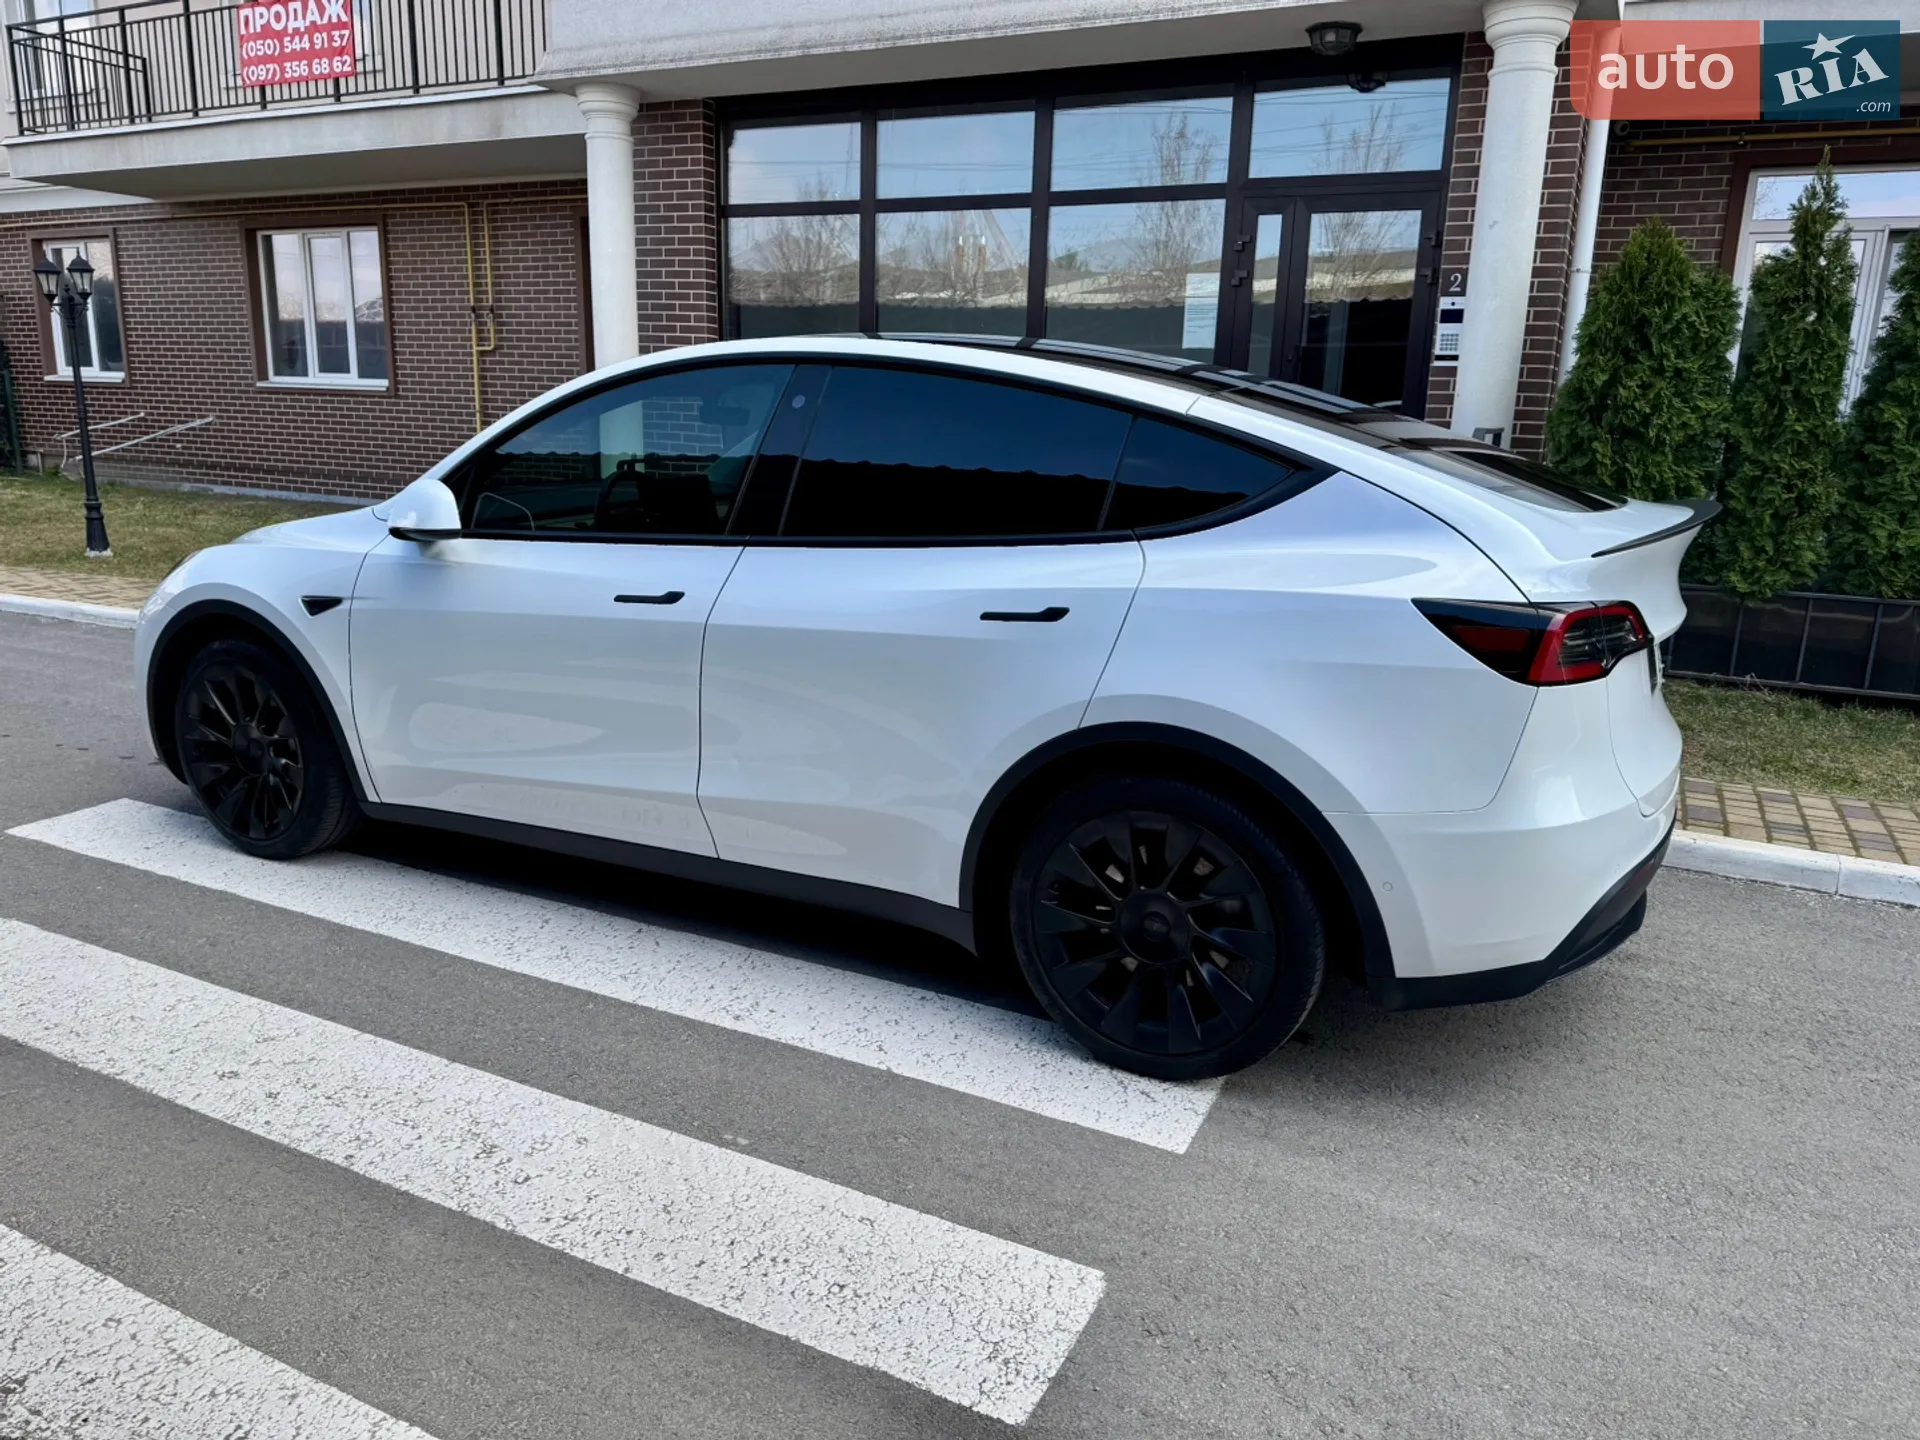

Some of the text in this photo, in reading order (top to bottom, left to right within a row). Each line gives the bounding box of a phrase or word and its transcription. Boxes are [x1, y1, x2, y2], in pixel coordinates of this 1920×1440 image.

[240, 0, 348, 34] ПРОДАЖ
[242, 29, 350, 59] (050) 544 91 37
[243, 55, 352, 83] (097) 356 68 62
[1449, 273, 1462, 292] 2
